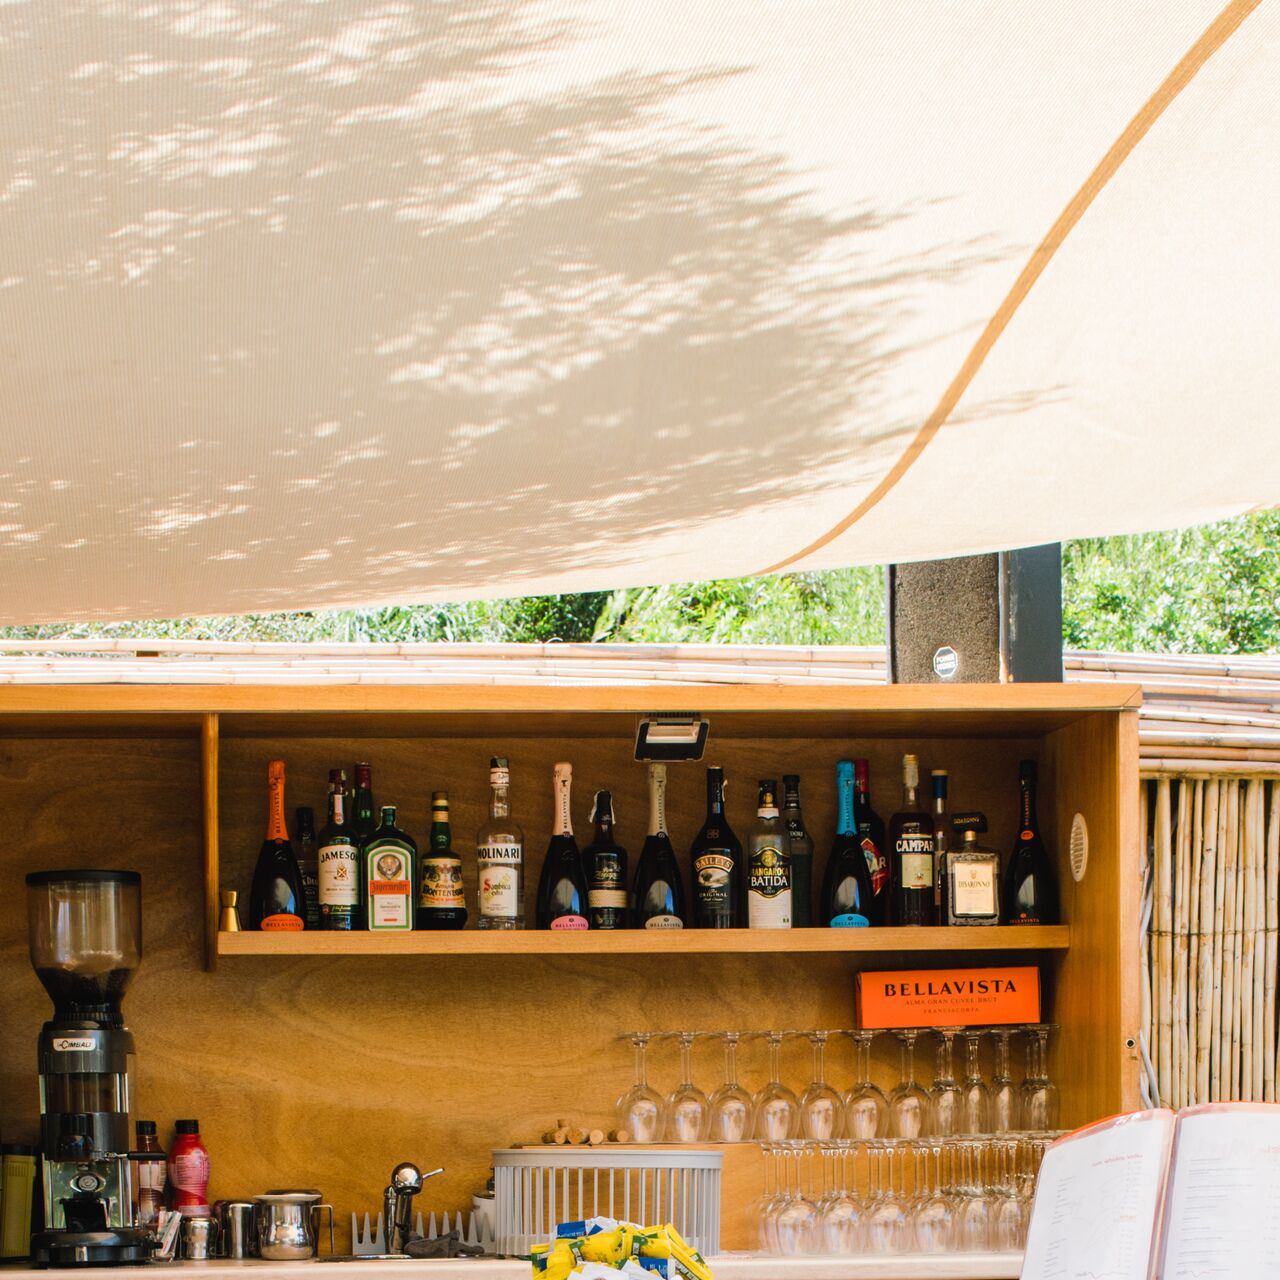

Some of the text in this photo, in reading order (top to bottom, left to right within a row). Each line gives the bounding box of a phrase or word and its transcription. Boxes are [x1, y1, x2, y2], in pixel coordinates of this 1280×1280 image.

[896, 840, 934, 852] CAMPAR
[696, 857, 731, 868] BAILEYS
[751, 876, 788, 886] BATIDA
[885, 980, 1017, 997] BELLAVISTA
